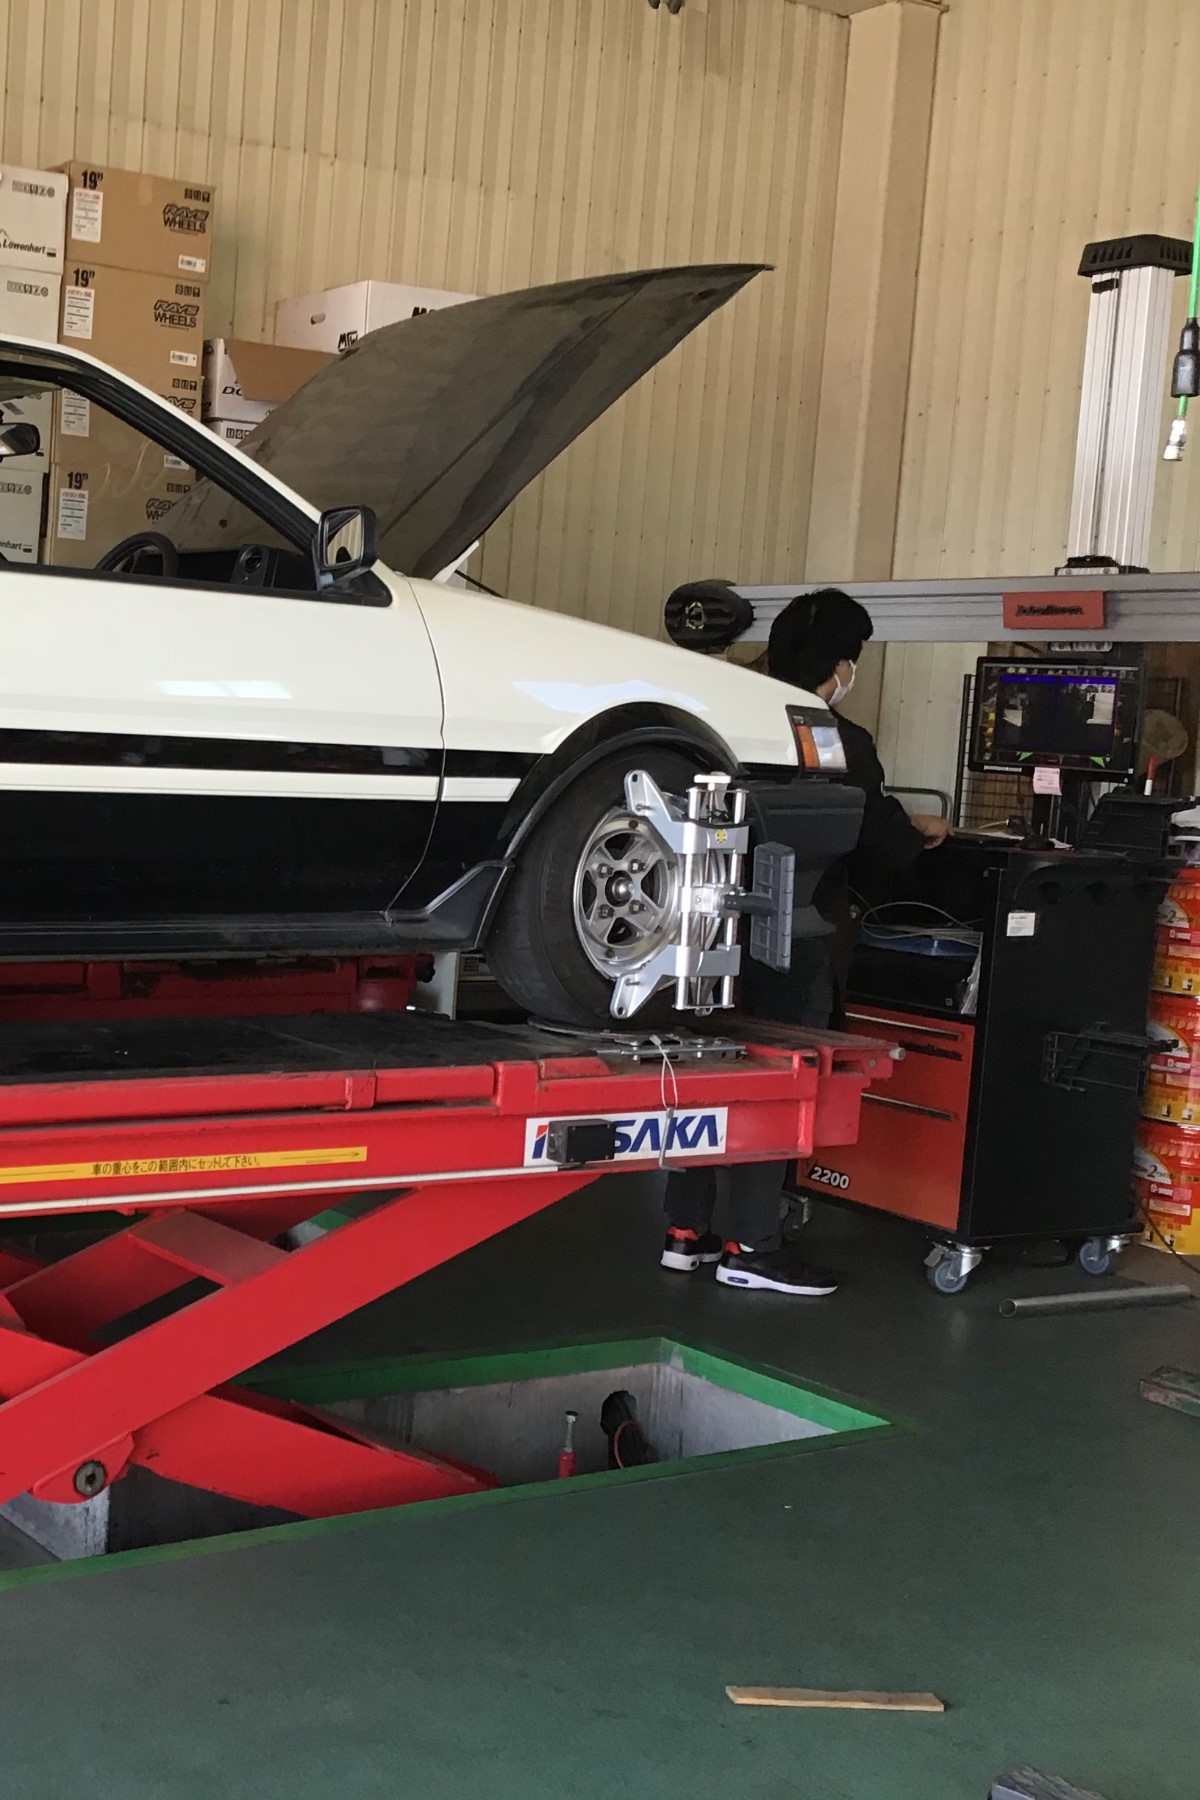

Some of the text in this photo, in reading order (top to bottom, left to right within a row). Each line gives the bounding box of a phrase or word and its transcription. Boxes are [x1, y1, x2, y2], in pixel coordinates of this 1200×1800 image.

[163, 215, 207, 234] WHEELS
[153, 310, 197, 329] WHEELS
[810, 1166, 850, 1189] 2200
